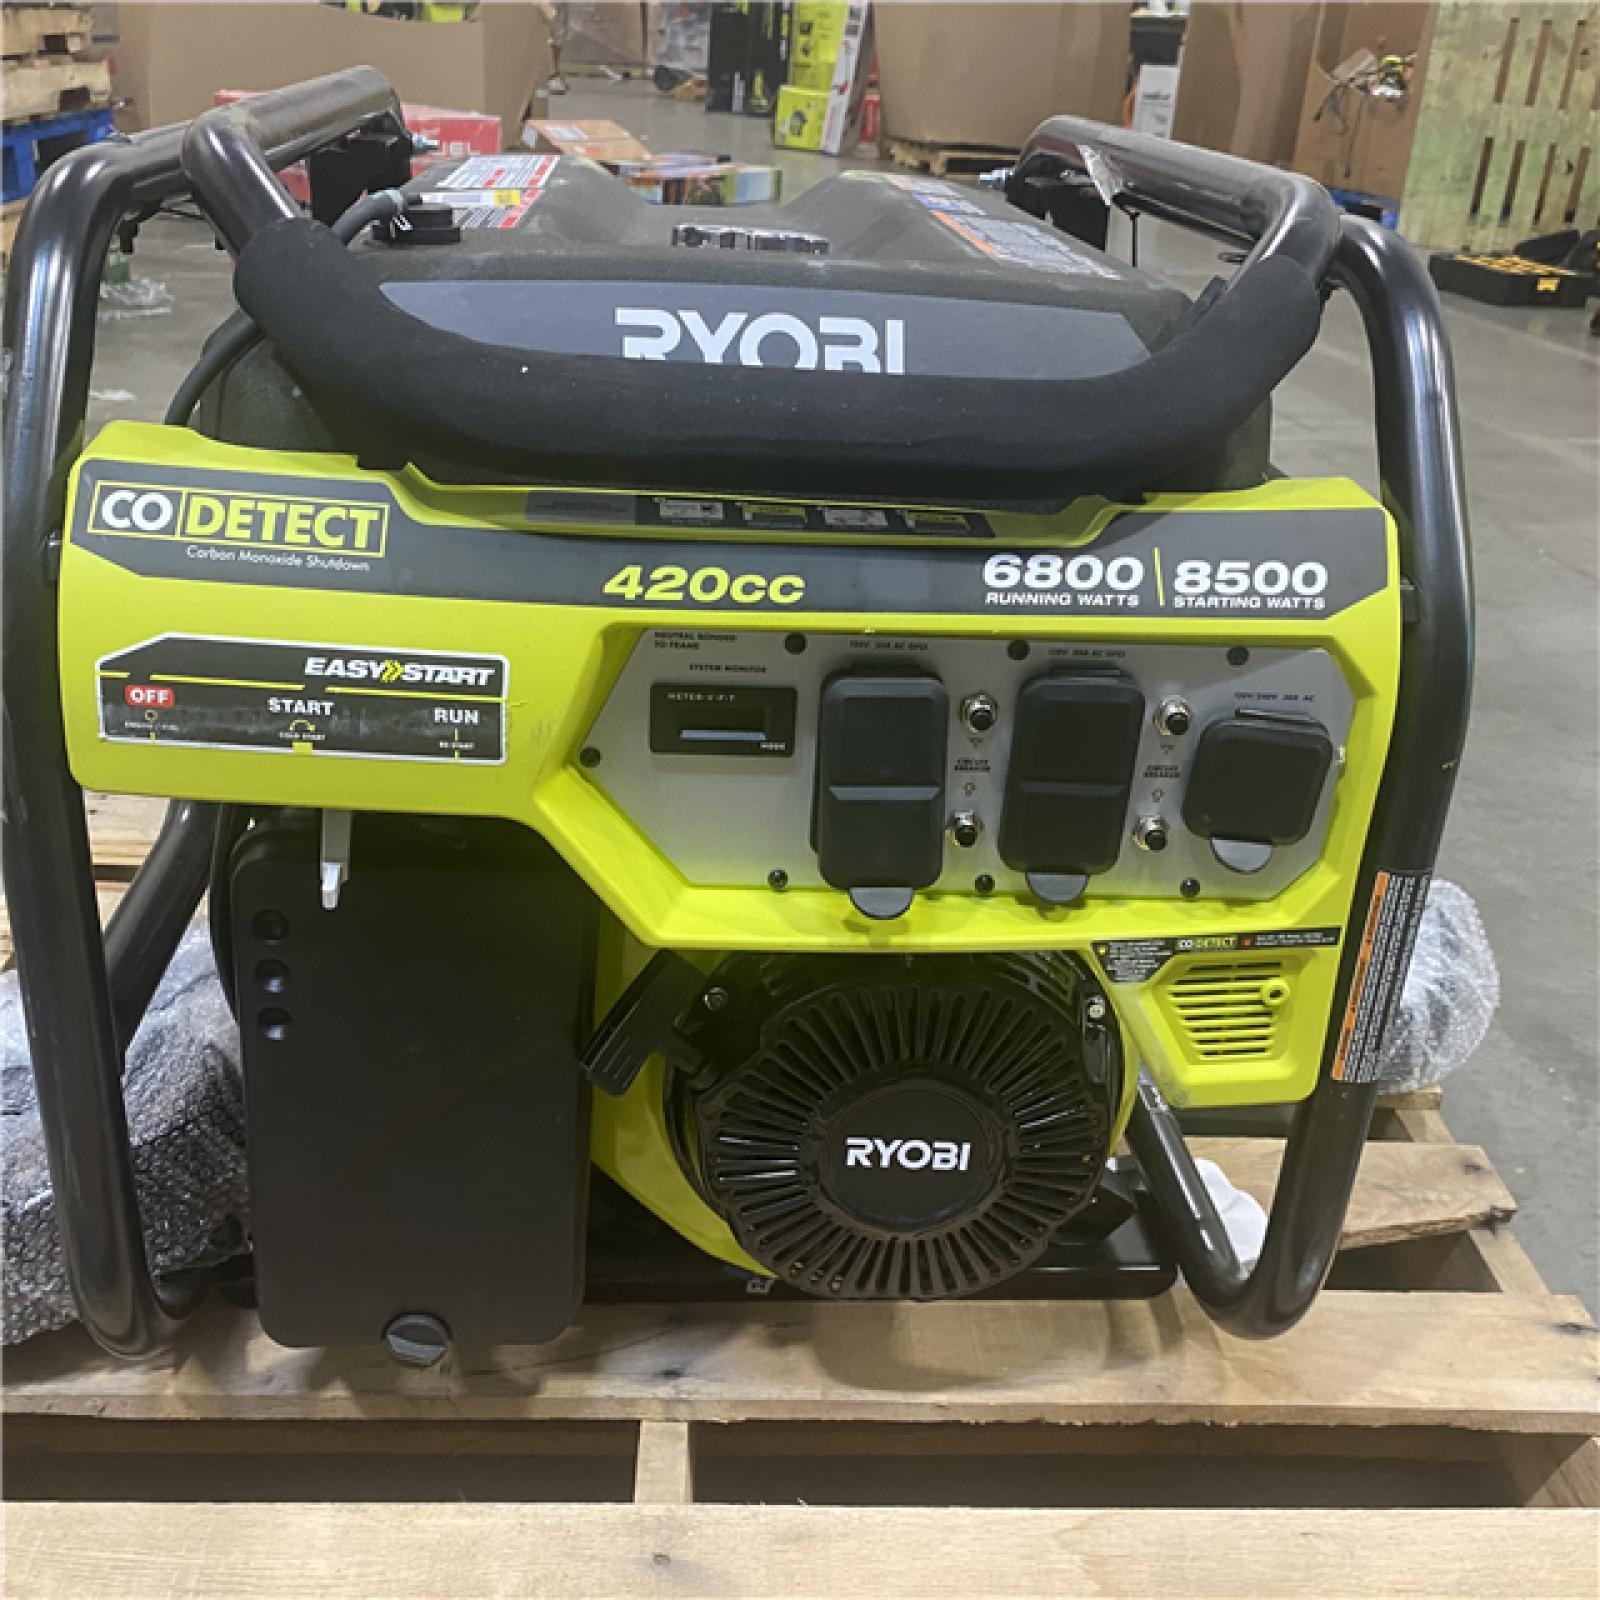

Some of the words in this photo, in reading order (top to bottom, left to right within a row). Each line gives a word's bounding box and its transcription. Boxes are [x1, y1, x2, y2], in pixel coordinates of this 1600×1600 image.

[615, 307, 905, 375] RYOBI
[101, 489, 173, 531] CO
[185, 494, 382, 549] DETECT
[185, 545, 236, 562] Carbon
[238, 549, 303, 567] Monoxide
[305, 554, 371, 572] Shutdown
[602, 564, 805, 603] 420cc
[983, 553, 1145, 591] 6800
[1173, 559, 1329, 597] 8500
[985, 592, 1072, 607] RUNNING
[1077, 593, 1141, 609] WATTS
[1173, 595, 1262, 610] STARTING
[1265, 596, 1327, 611] WATTS
[303, 656, 386, 680] EASY
[401, 662, 496, 686] START
[129, 687, 170, 704] OFF
[267, 697, 335, 716] START
[433, 707, 480, 726] RUN
[846, 1136, 971, 1171] RYOBI
